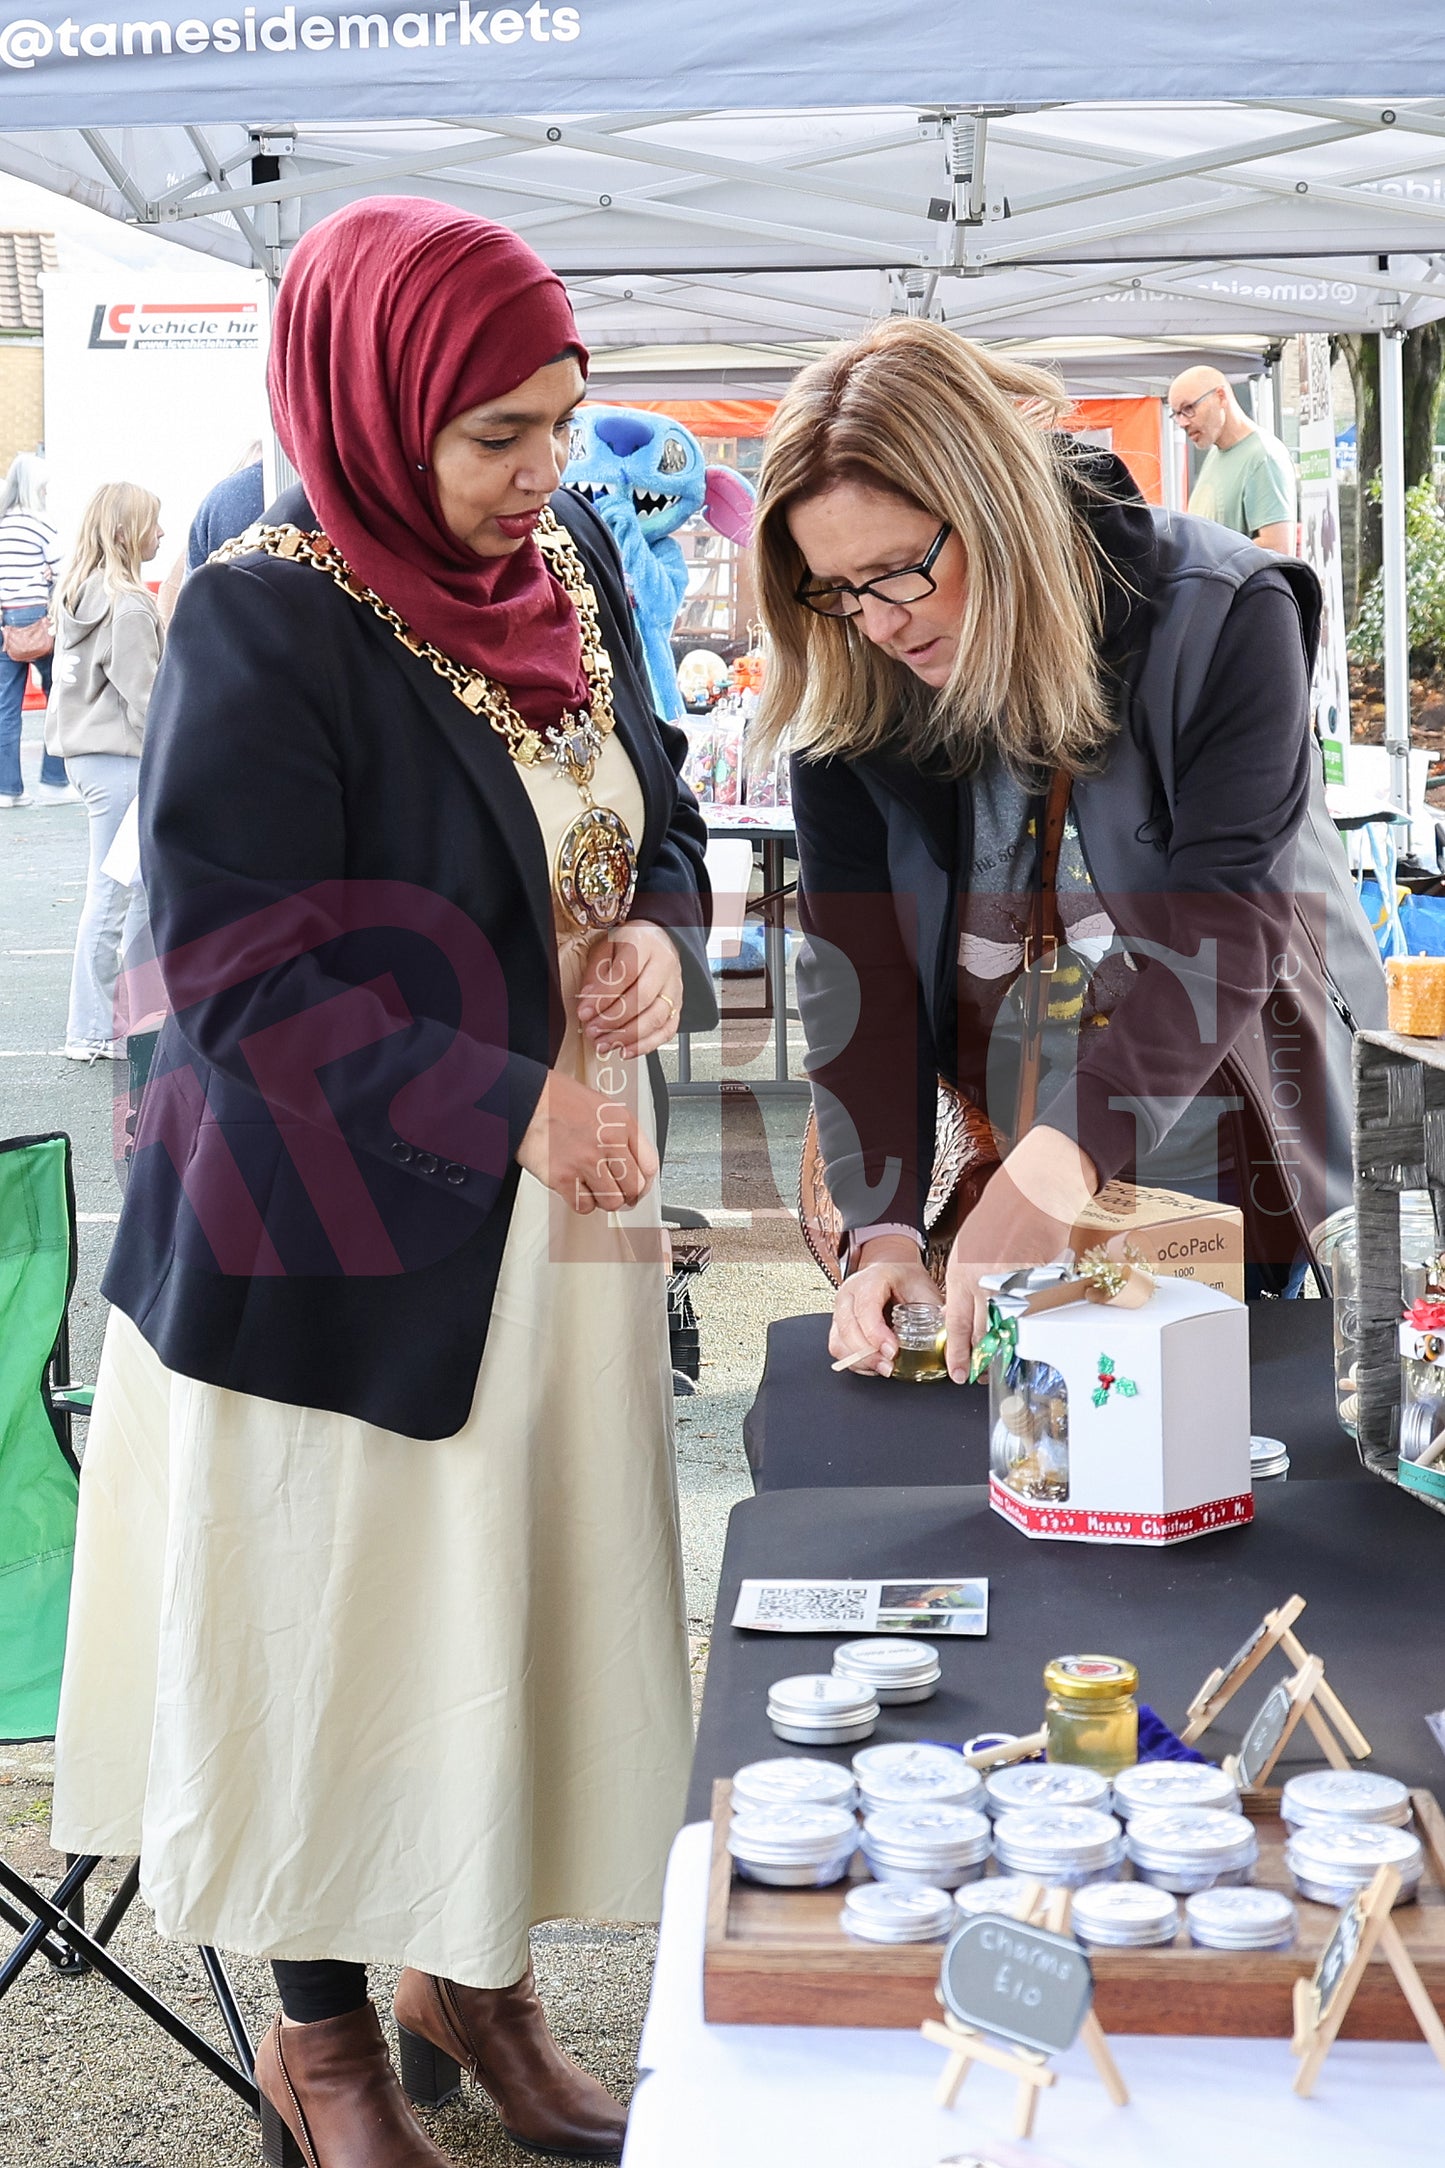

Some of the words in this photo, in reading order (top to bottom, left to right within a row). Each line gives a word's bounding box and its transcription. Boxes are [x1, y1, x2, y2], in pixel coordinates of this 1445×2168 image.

[0, 0, 581, 69] @tamesidemarkets
[139, 320, 219, 334] vehicle
[1158, 1233, 1225, 1262] oCoPack
[1174, 1266, 1195, 1278] 1000
[1141, 1517, 1195, 1536] Christmas
[993, 1963, 1042, 2007] £10
